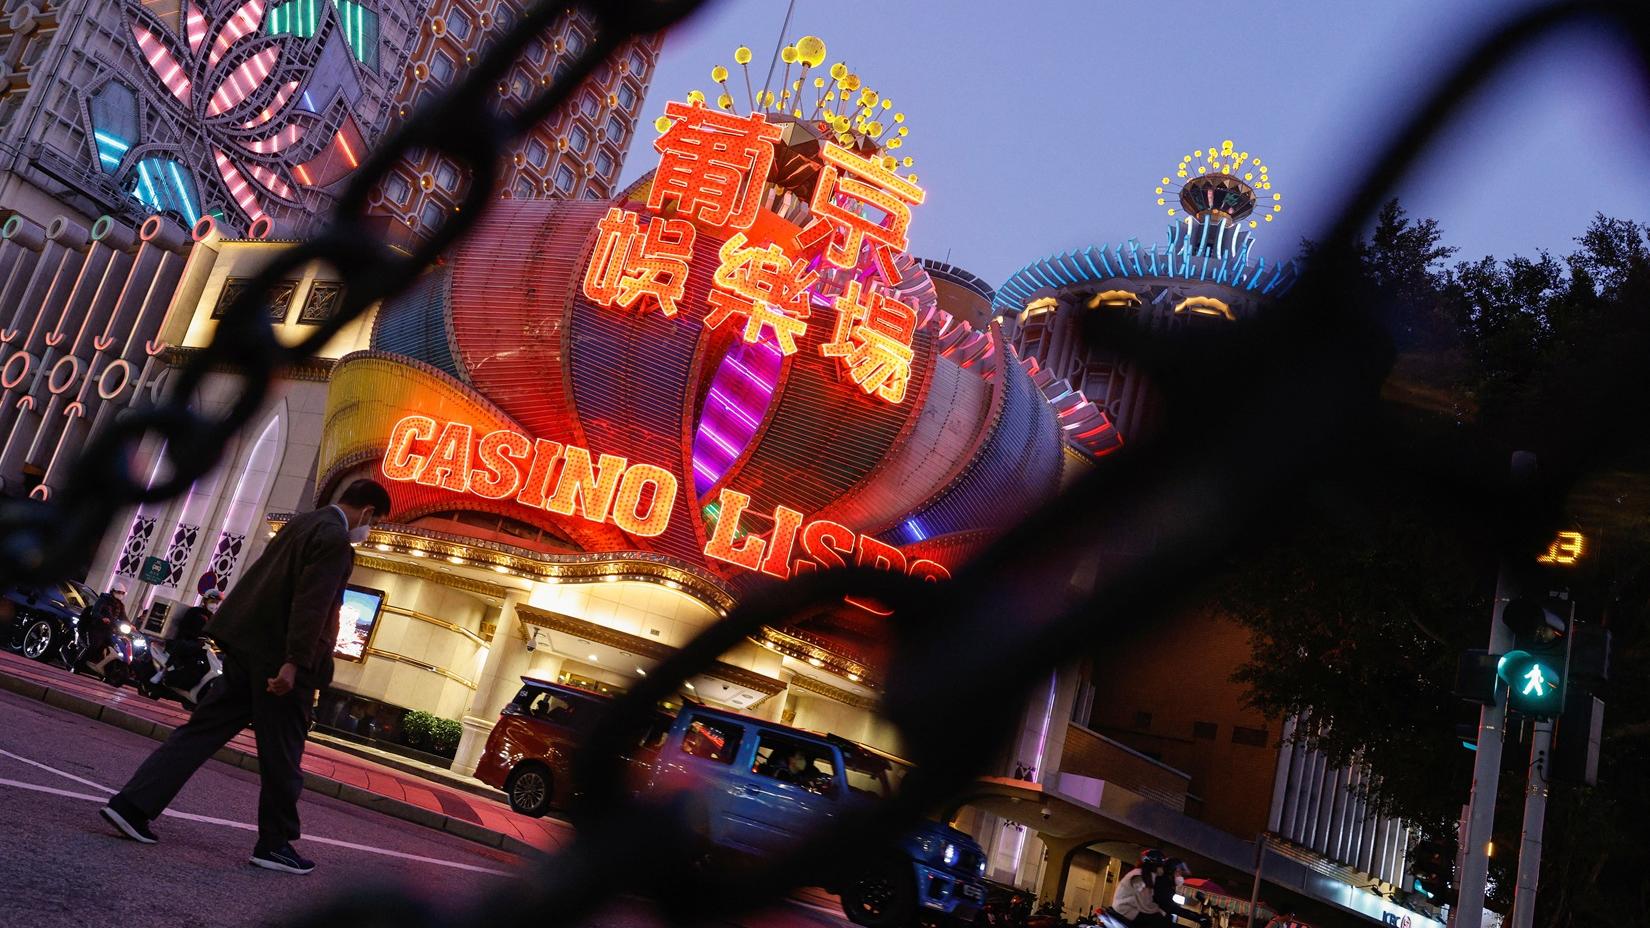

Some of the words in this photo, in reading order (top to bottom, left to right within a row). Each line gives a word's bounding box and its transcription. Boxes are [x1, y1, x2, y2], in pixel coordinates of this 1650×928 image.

[646, 100, 926, 287] 葡京
[382, 415, 678, 537] CASINO
[703, 488, 952, 616] LIS
